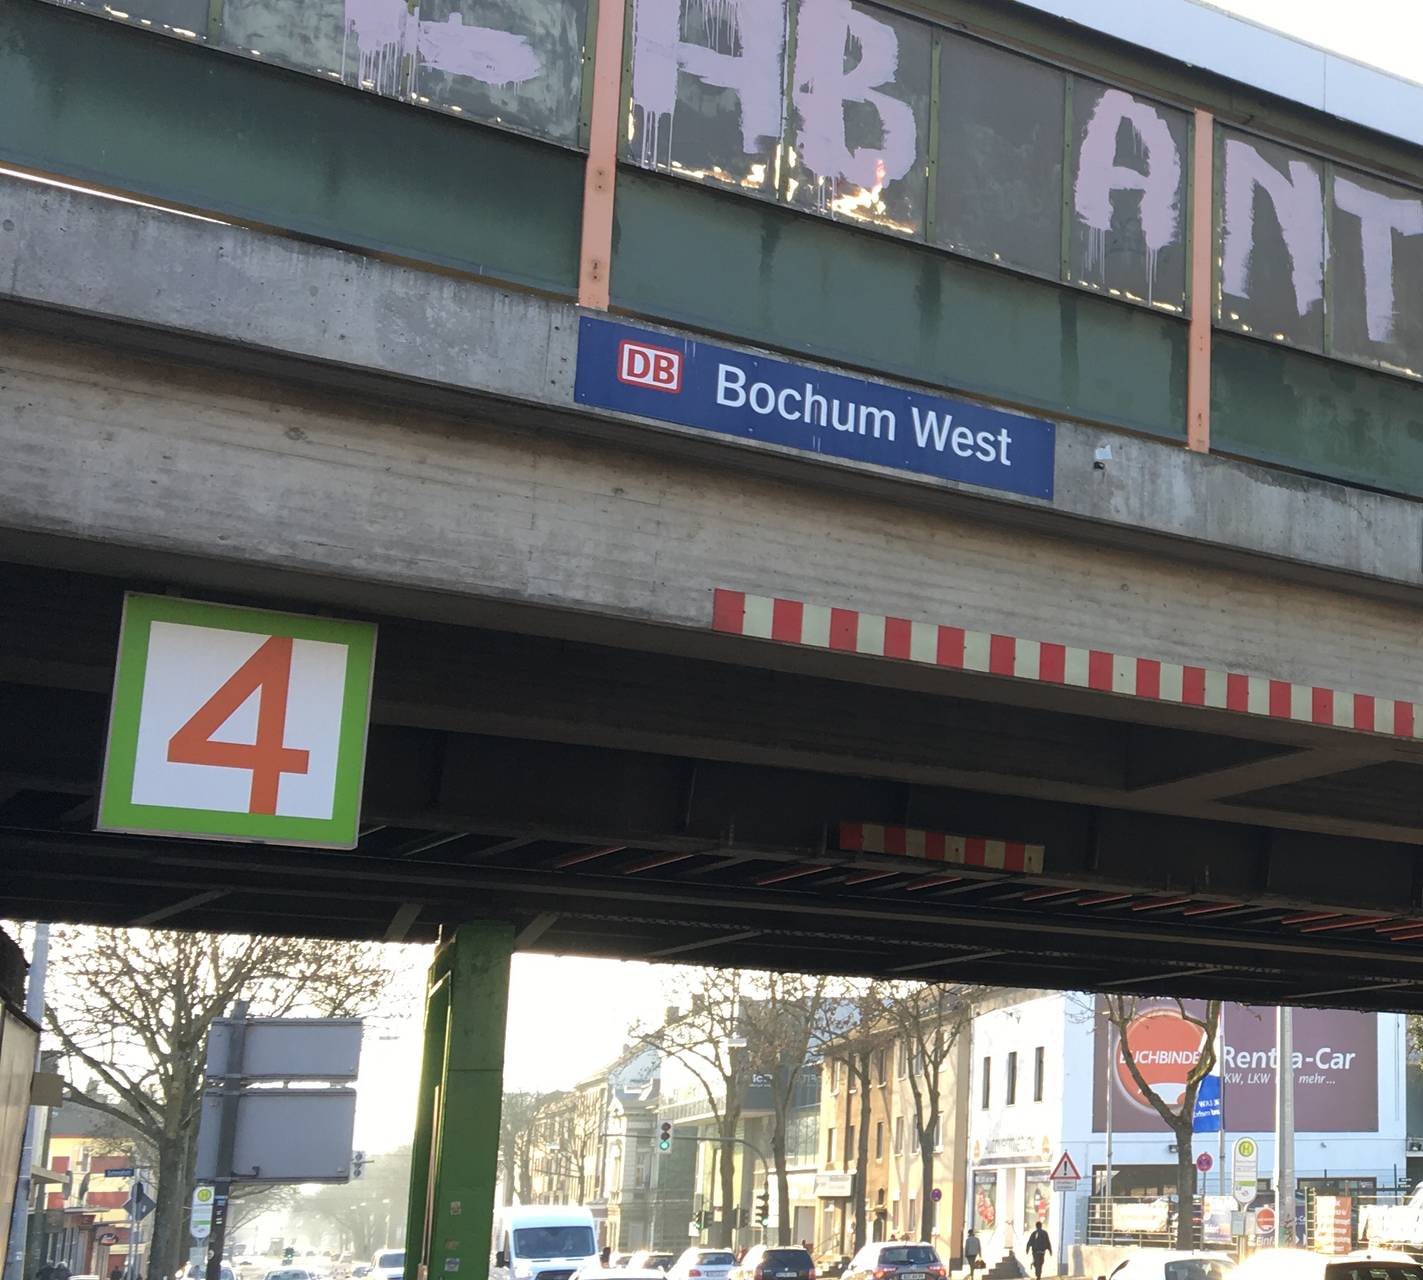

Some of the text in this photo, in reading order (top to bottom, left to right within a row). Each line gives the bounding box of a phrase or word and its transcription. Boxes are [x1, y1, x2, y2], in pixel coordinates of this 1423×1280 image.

[625, 348, 676, 386] DB
[716, 363, 1013, 467] Bochum West
[166, 635, 310, 816] 4
[1223, 1072, 1245, 1085] KW,
[1248, 1072, 1271, 1084] LKW
